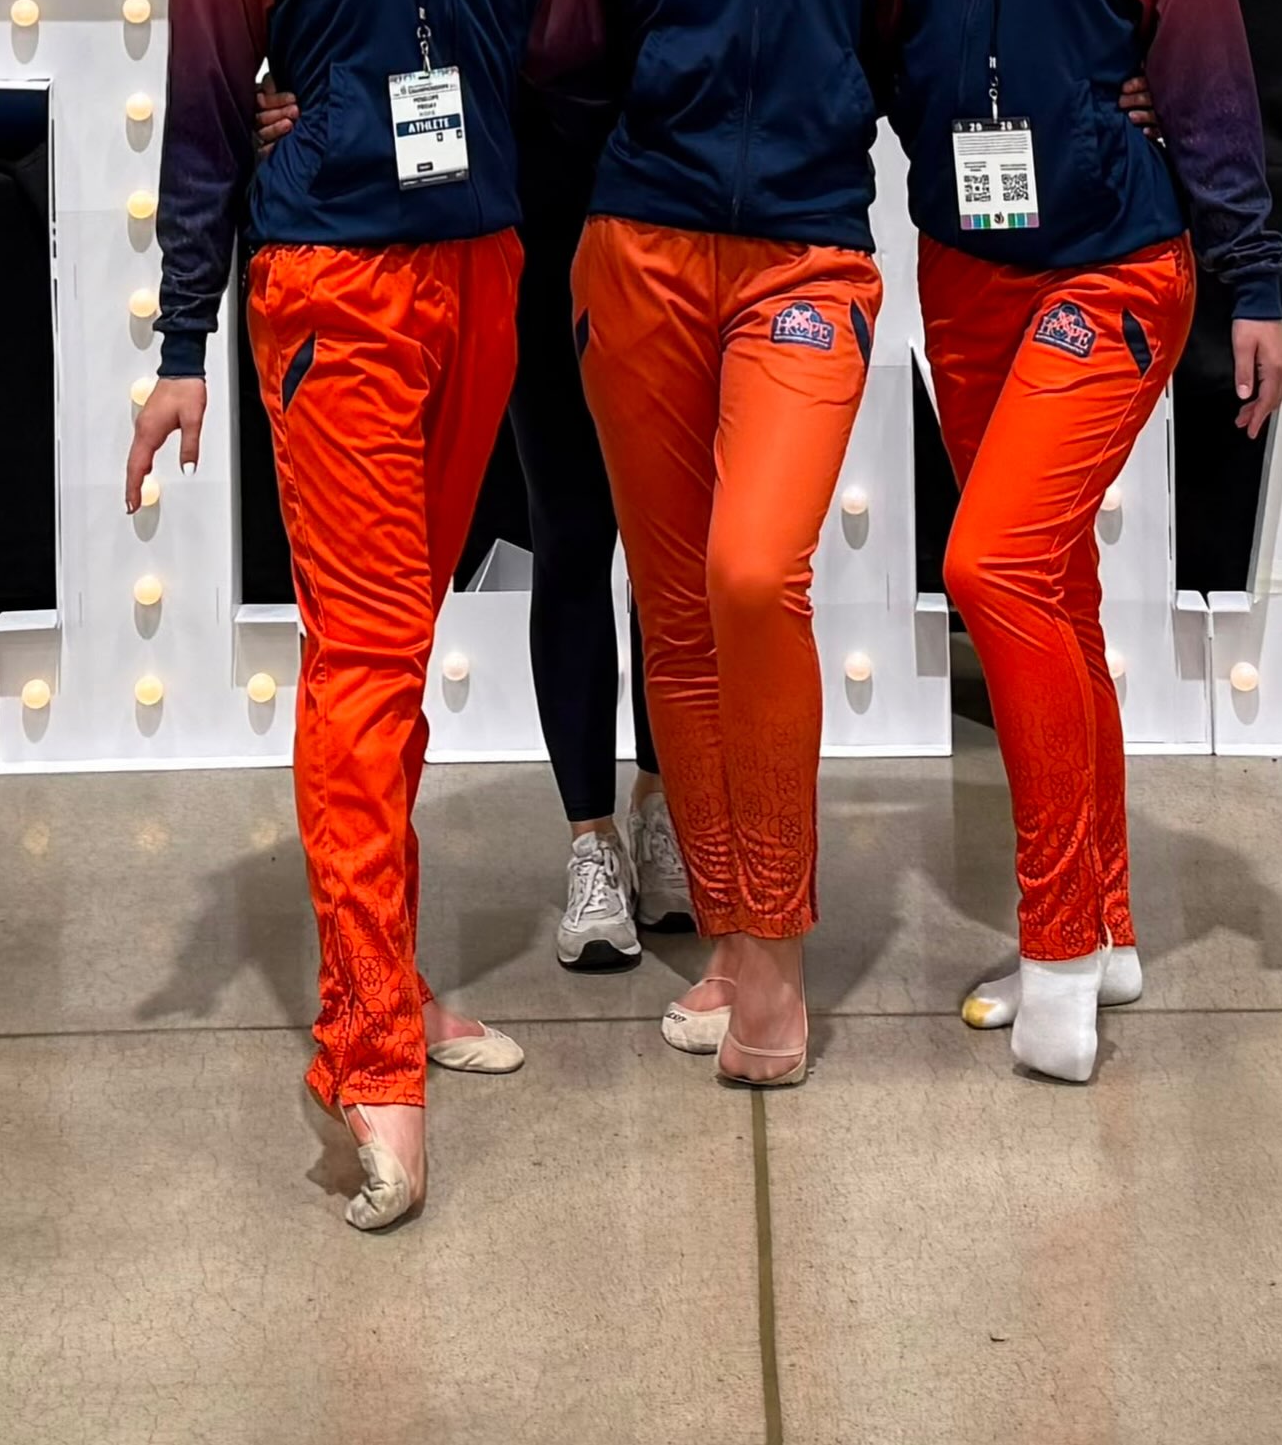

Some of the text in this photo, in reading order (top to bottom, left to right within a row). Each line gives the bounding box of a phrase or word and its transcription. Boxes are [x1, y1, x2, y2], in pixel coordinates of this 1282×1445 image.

[408, 117, 451, 134] ATHLETE
[774, 315, 833, 343] HOPE
[1037, 316, 1093, 350] HOPE
